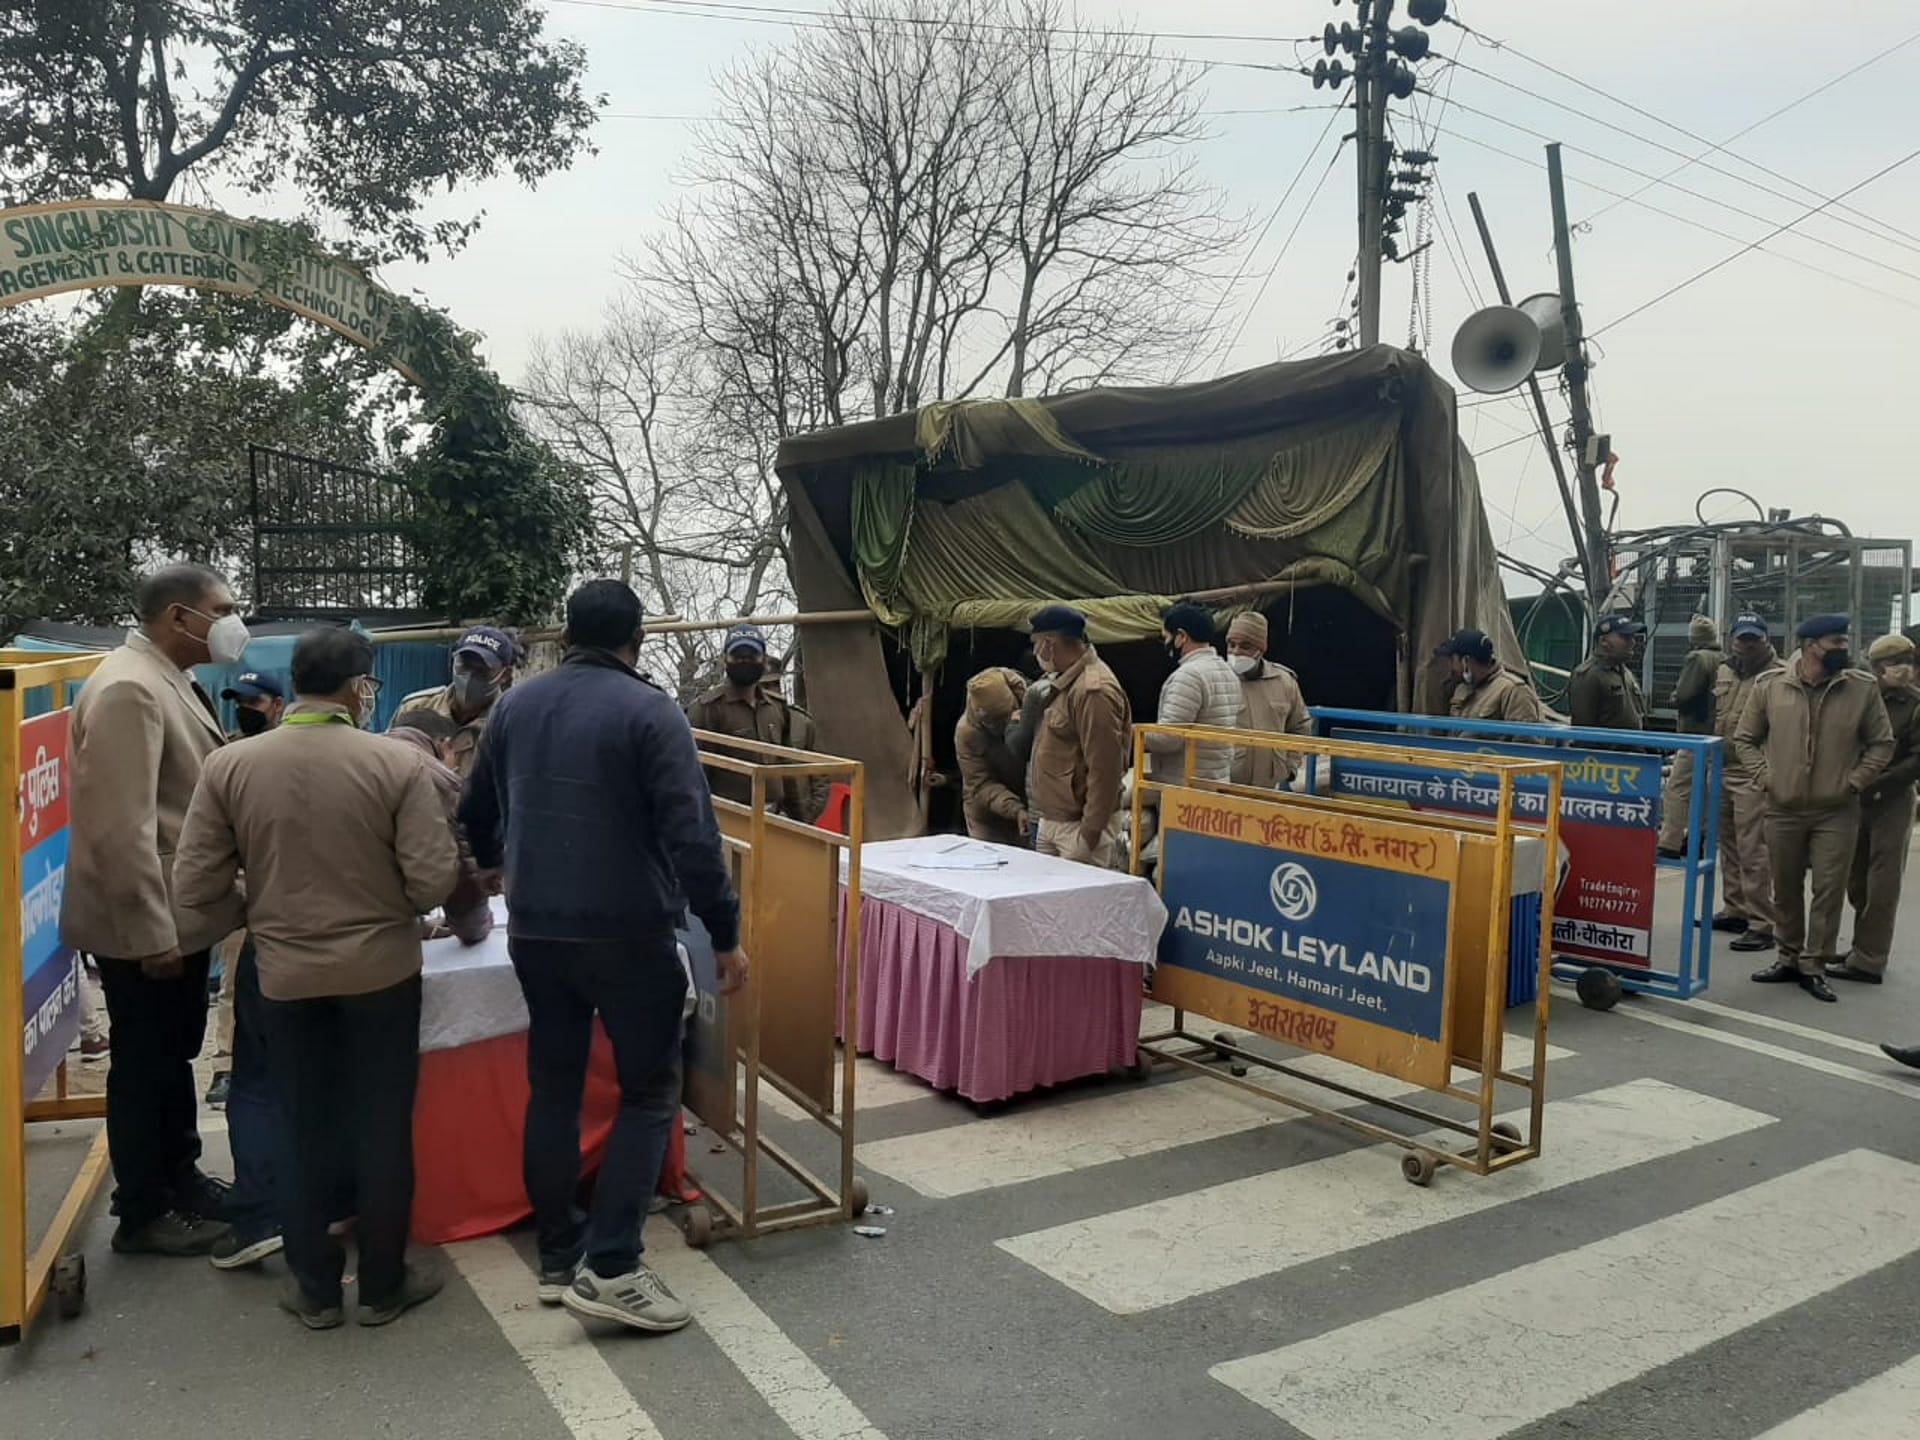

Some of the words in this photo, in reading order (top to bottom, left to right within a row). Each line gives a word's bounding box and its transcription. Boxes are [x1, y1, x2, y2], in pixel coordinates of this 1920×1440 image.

[4, 210, 97, 258] SINGH
[96, 208, 173, 248] BISHT
[118, 250, 134, 273] &
[27, 744, 60, 838] पुलिस
[1341, 772, 1422, 798] यातायात
[1427, 776, 1448, 800] के
[1517, 791, 1547, 812] का
[1616, 797, 1653, 826] करें
[1177, 803, 1252, 837] यातायात
[1173, 906, 1273, 953] ASHOK
[1280, 930, 1431, 993] LEYLAND
[1205, 947, 1245, 972] Aapki
[1247, 960, 1284, 983] Jeet.
[1286, 970, 1344, 1000] Hamari
[1347, 984, 1388, 1013] Jeet.
